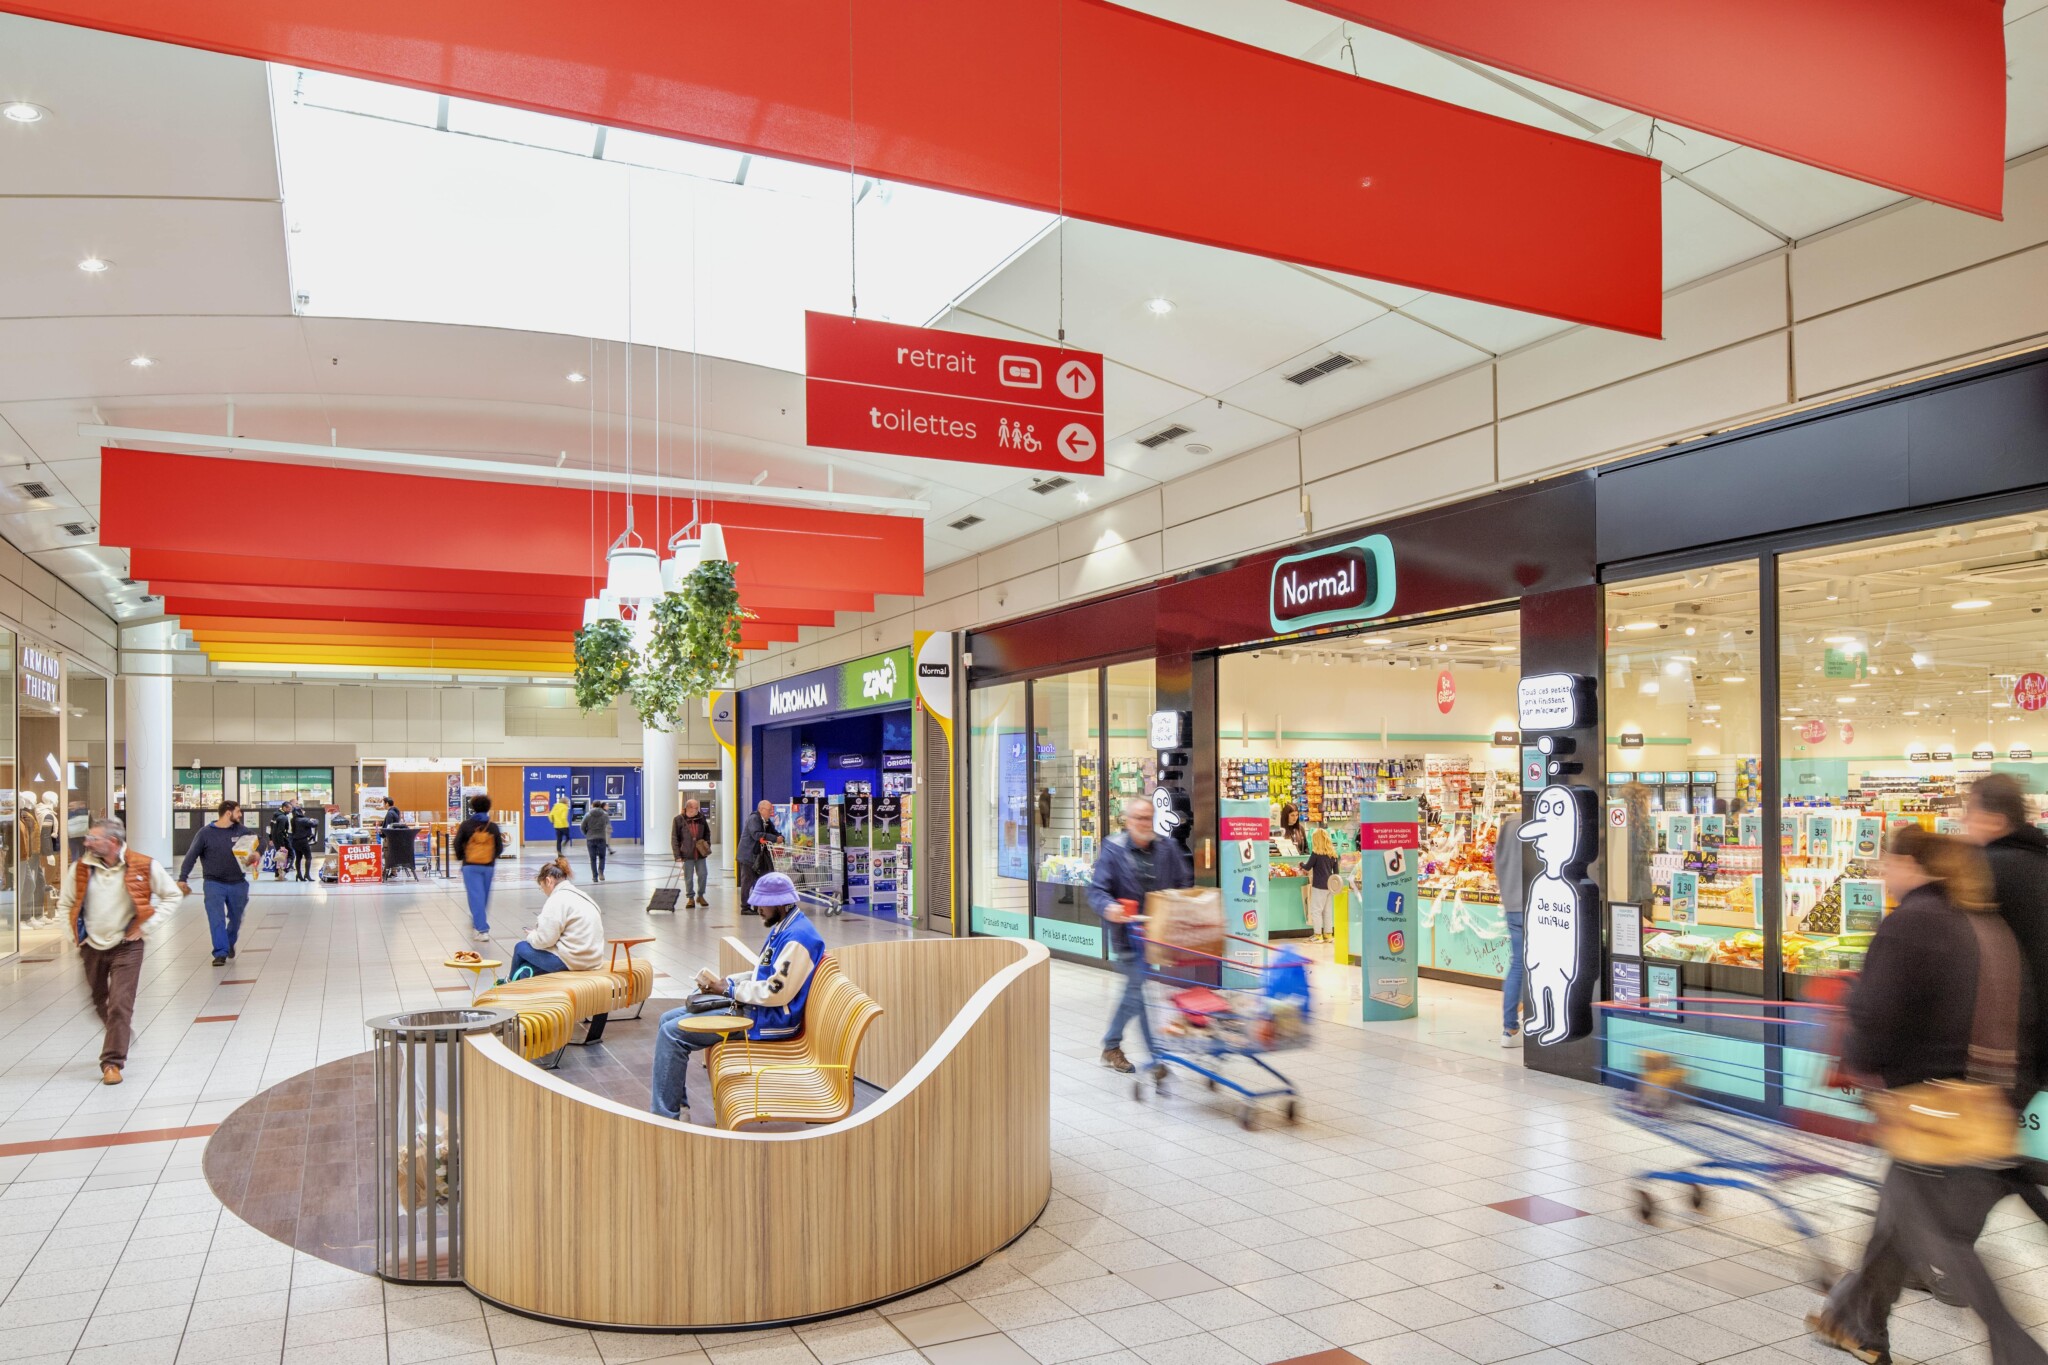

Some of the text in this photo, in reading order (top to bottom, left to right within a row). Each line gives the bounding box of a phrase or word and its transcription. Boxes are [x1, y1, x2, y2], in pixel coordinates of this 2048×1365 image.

[897, 347, 976, 374] retrait
[869, 407, 977, 439] toilettes
[1283, 560, 1355, 607] Normal
[23, 647, 59, 679] ARMAND
[921, 665, 947, 675] Normal
[25, 674, 57, 703] THIERY
[1521, 686, 1570, 696] Tous ces petits
[769, 683, 828, 716] MICROMANIA
[1524, 697, 1566, 706] prix finissent
[1522, 708, 1533, 716] par
[887, 759, 912, 767] ORIGINA
[186, 770, 221, 779] Carrefo
[877, 804, 896, 812] FC25
[347, 845, 371, 854] COLIS
[343, 852, 376, 861] PERDUS
[1677, 882, 1692, 895] 1.30
[1853, 893, 1873, 905] 1.40
[1537, 898, 1572, 914] Je suis
[1537, 915, 1570, 930] unique
[1052, 928, 1061, 939] bas
[1061, 933, 1068, 941] et
